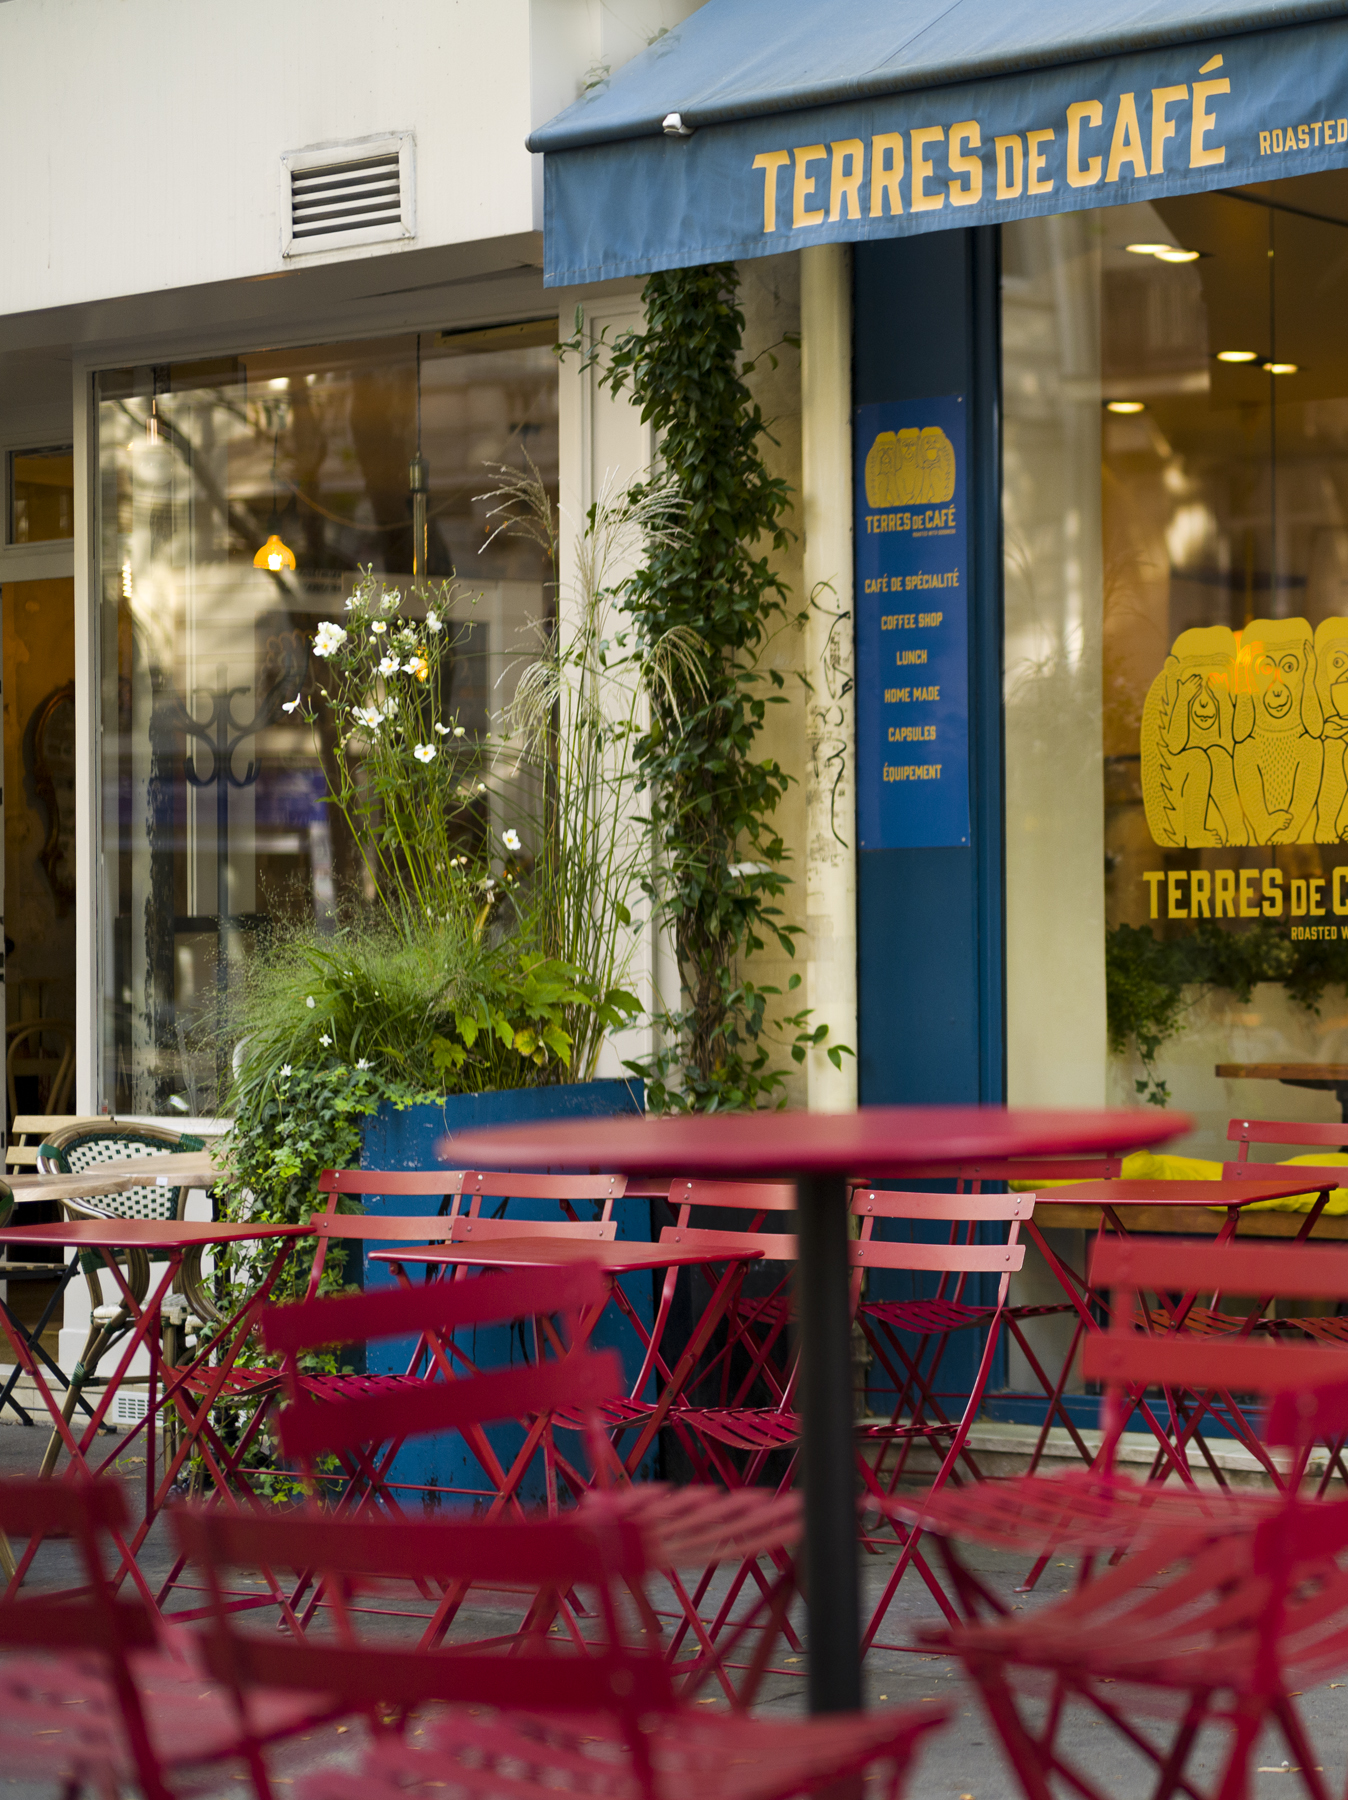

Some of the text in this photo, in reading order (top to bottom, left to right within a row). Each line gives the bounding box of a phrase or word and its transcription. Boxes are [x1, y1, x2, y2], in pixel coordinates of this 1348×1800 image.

[751, 53, 1231, 233] TERRES DE CAFÉ
[1258, 118, 1348, 156] ROASTED
[864, 504, 957, 534] TERRES DE CAFÉ
[864, 567, 960, 594] CAFÉ DE SPÉCIALITÉ
[881, 611, 943, 631] COFFEE SHOP
[896, 649, 928, 666] LUNCH
[884, 685, 940, 704] HOME MADE
[888, 725, 937, 742] CAPSULES
[883, 761, 943, 783] ÉQUIPEMENT
[1142, 867, 1284, 919] TERRES
[1290, 877, 1326, 916] DE
[1291, 926, 1338, 940] ROASTED
